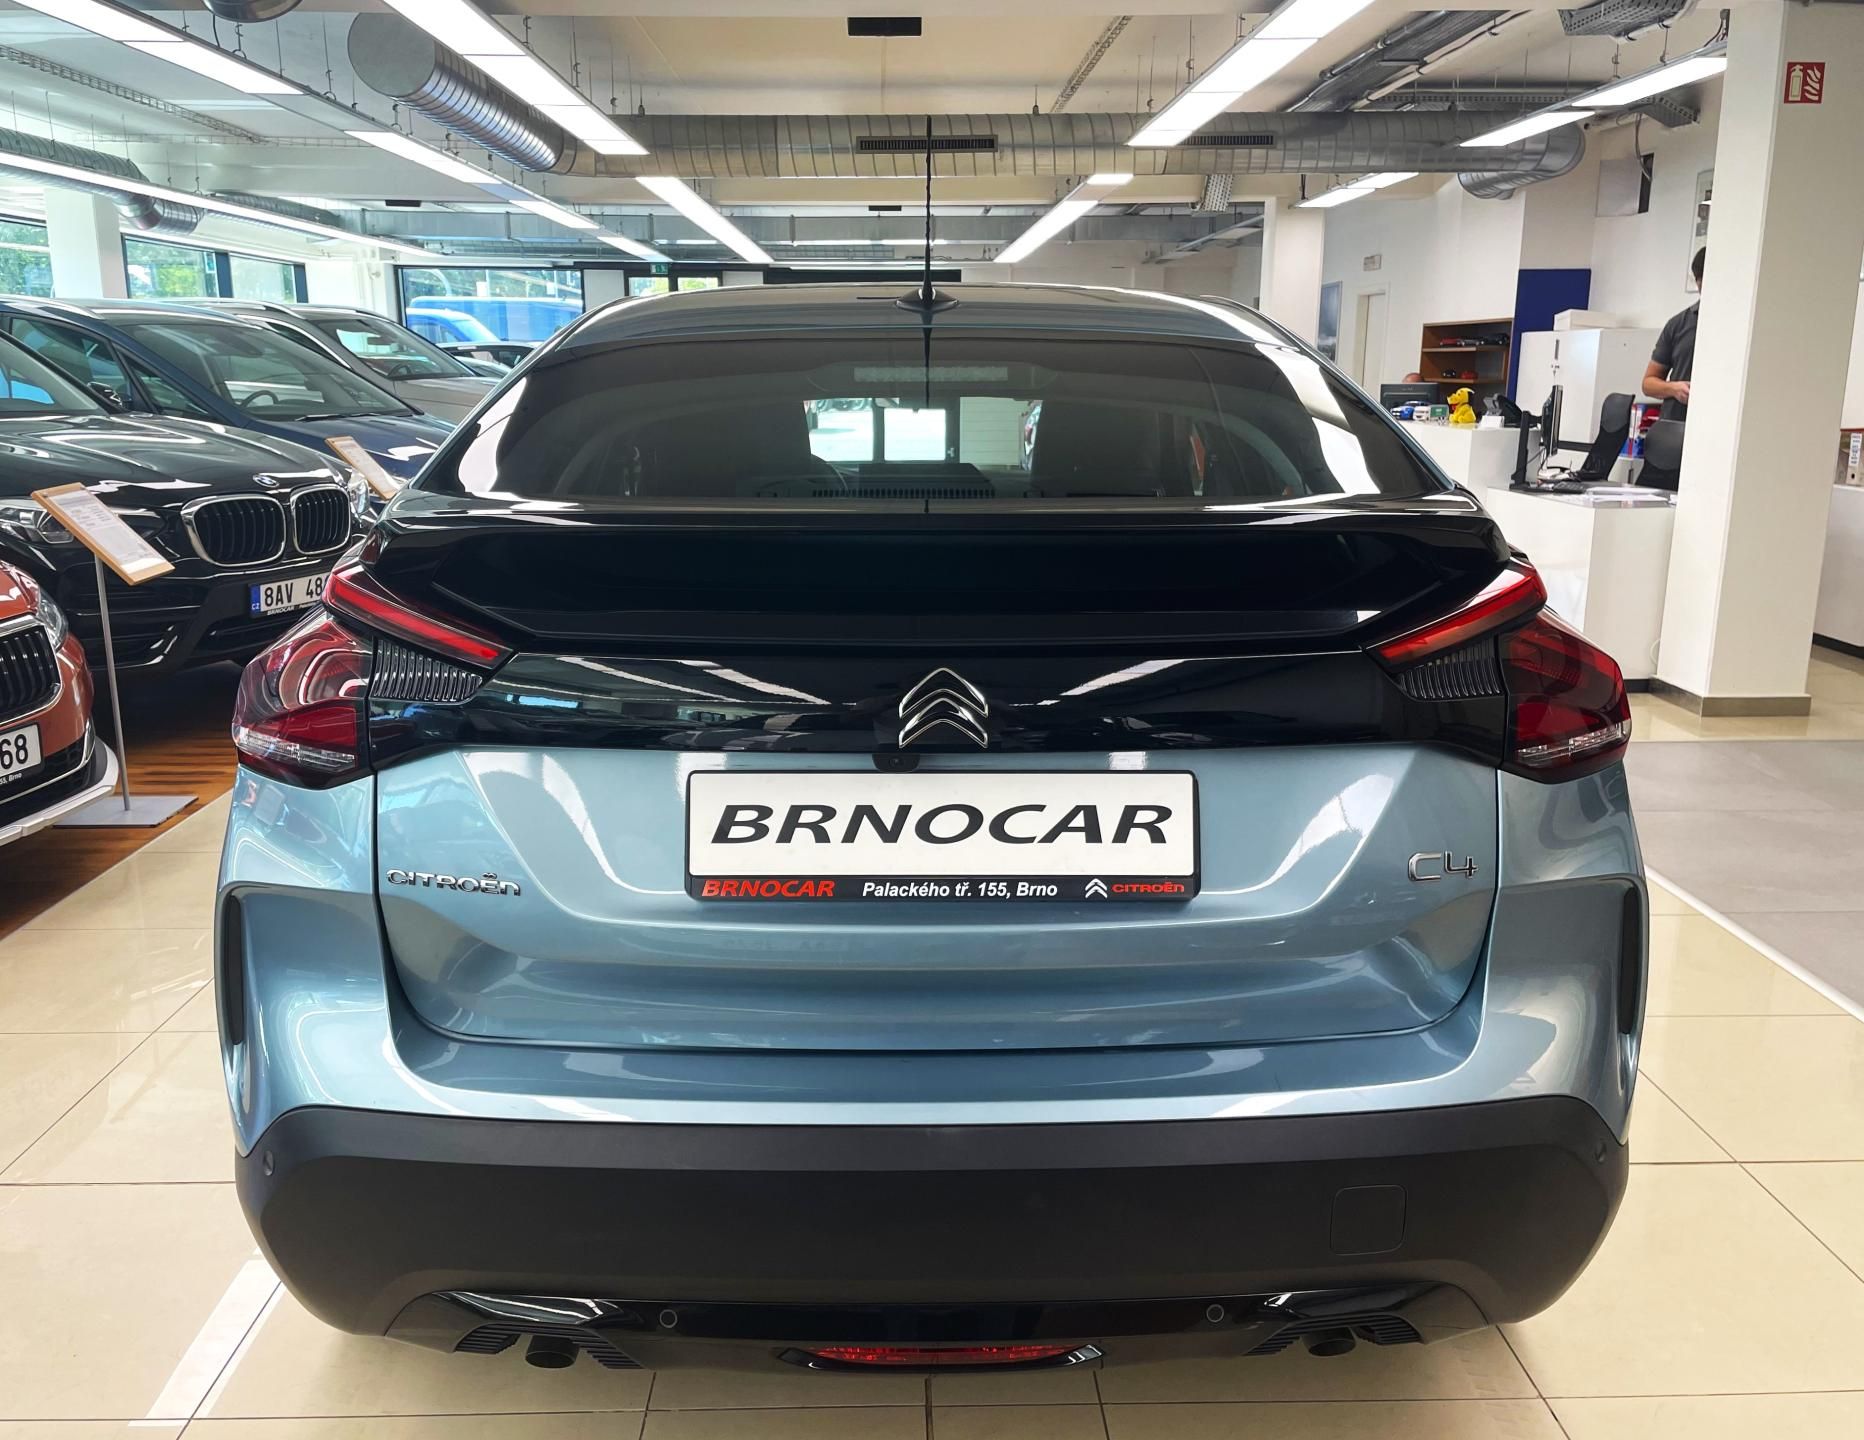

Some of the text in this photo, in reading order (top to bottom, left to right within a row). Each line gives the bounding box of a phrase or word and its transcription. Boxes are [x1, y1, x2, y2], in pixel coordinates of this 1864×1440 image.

[264, 575, 329, 607] 8AV 48
[710, 804, 1173, 845] BRNOCAR
[1408, 851, 1479, 882] C4
[386, 869, 521, 896] CITROËN
[701, 879, 1185, 899] BRNOCAR Palackého tř. 155, Brno CITROËN
